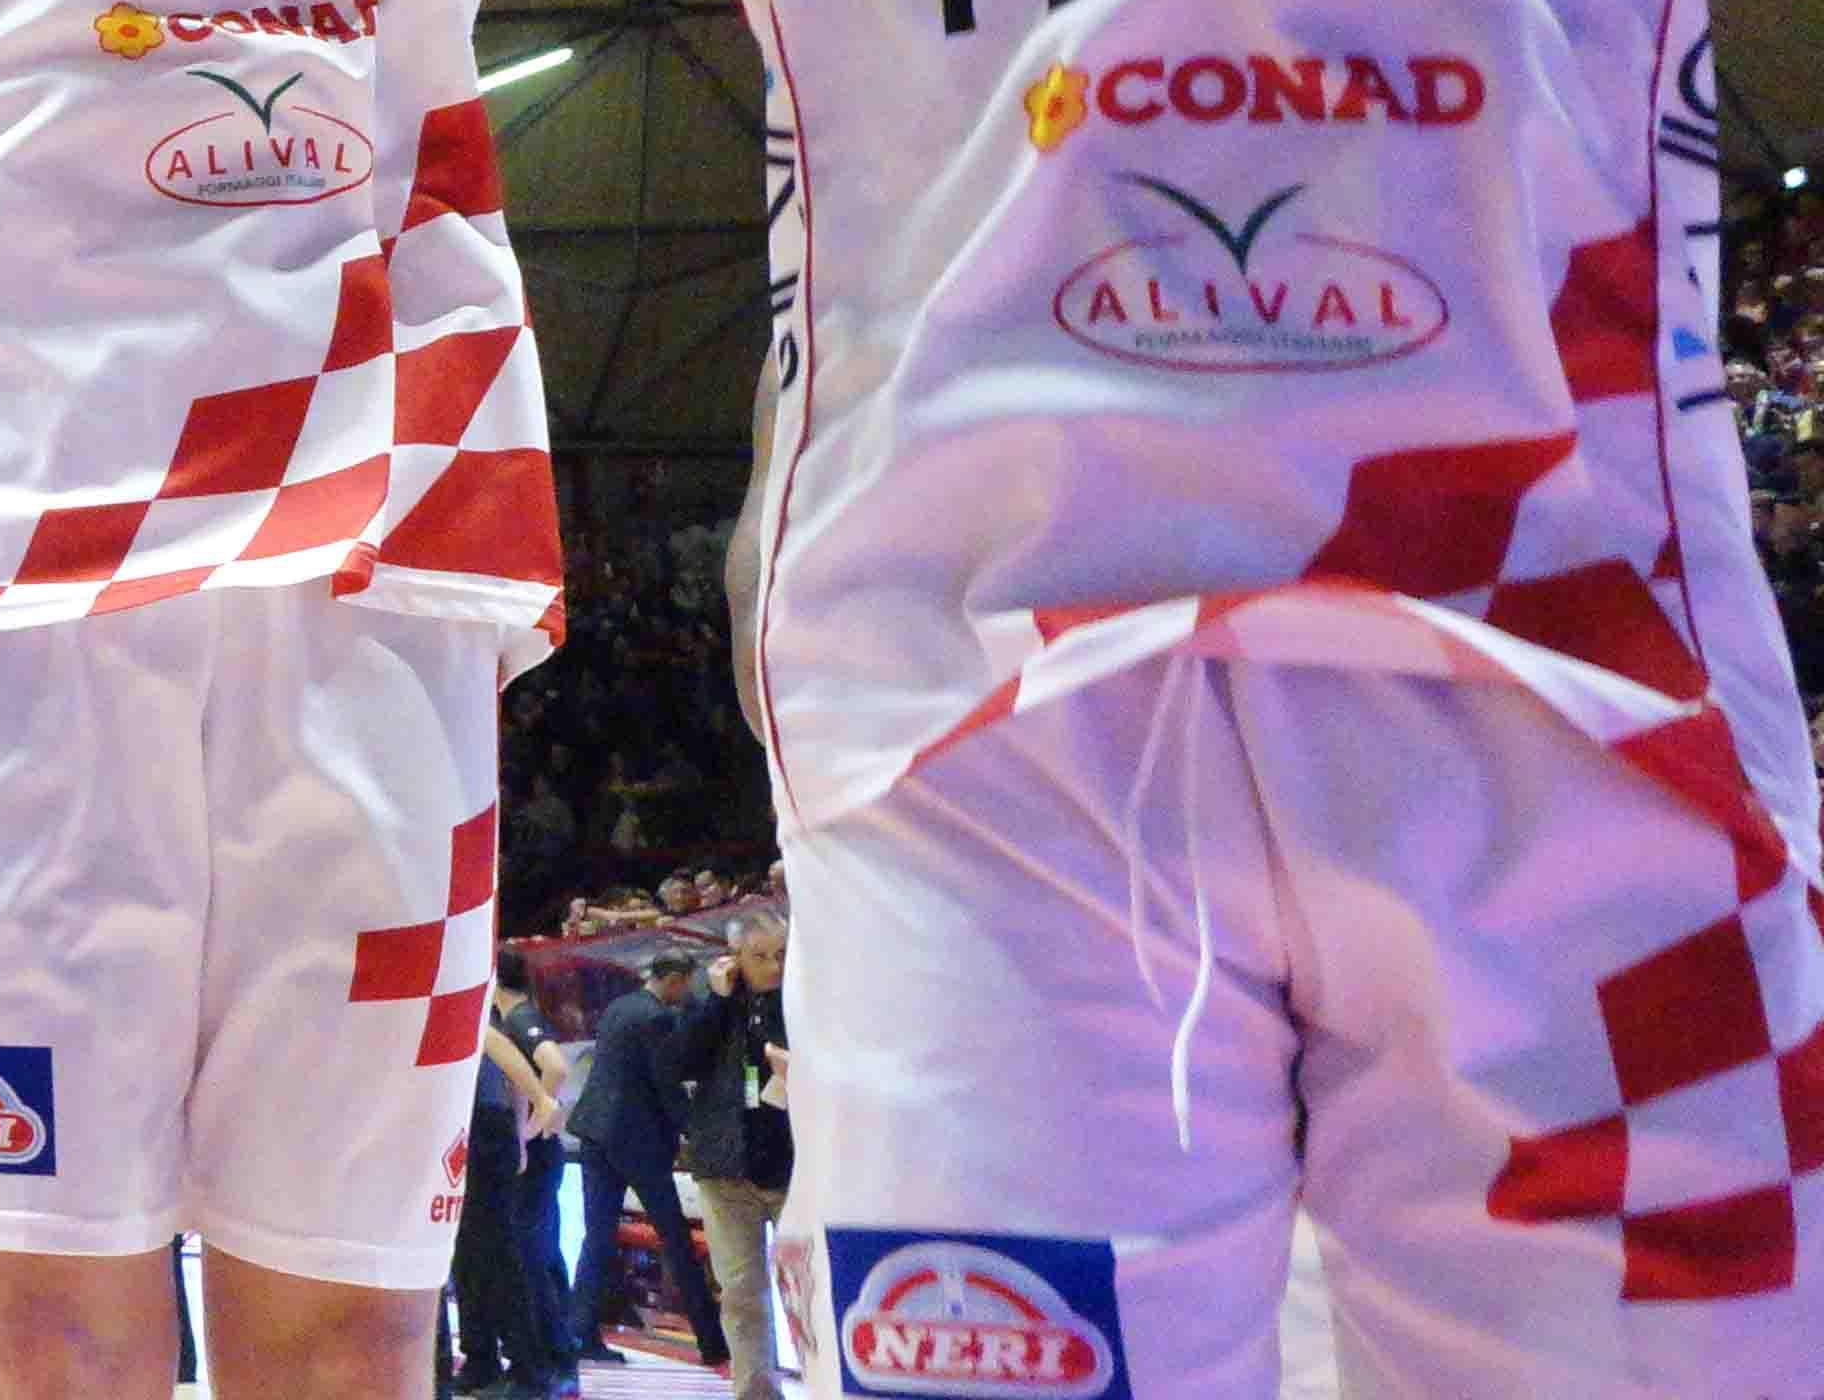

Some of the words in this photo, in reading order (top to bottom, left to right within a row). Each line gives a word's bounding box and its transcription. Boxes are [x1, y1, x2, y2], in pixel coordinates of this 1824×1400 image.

[1096, 56, 1484, 127] CONAD
[167, 137, 352, 179] ALIVAL
[1089, 279, 1414, 327] ALIVAL
[871, 1321, 1072, 1376] NERI
